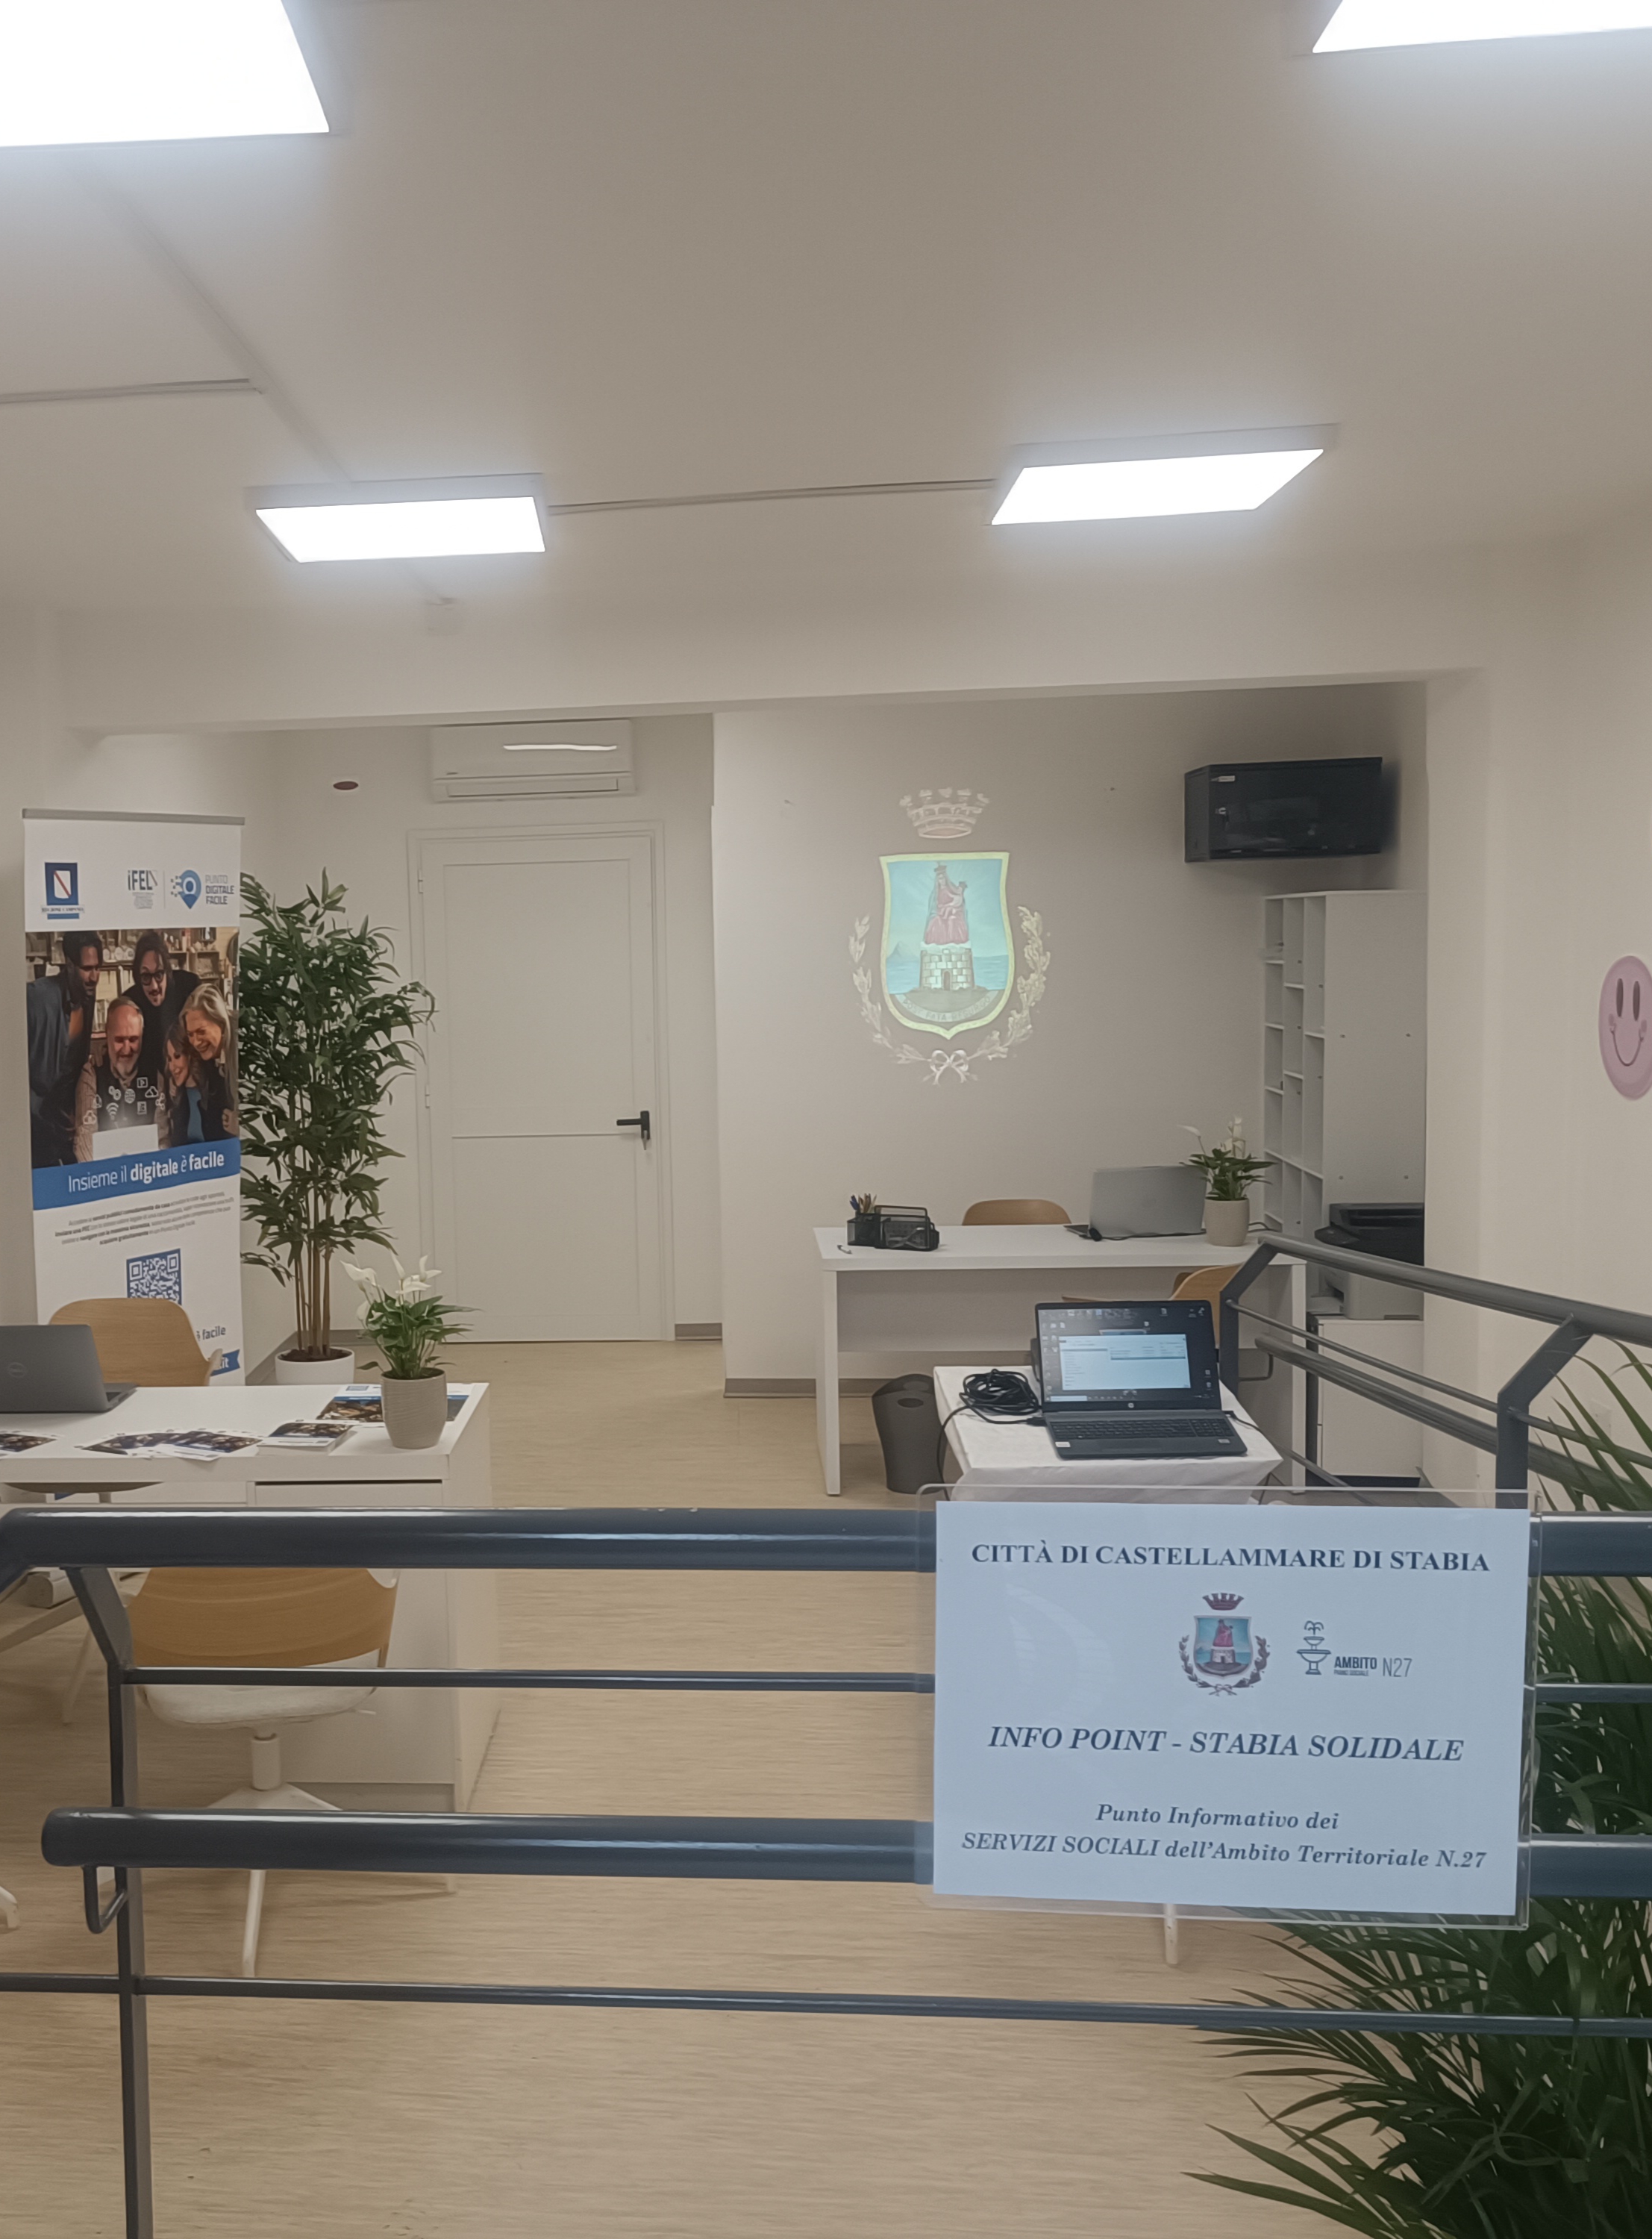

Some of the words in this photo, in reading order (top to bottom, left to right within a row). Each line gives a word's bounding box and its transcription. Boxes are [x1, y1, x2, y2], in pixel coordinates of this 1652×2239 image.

[205, 875, 228, 884] PUNTO
[206, 885, 234, 895] DIGITALE
[206, 896, 228, 905] FACILE
[68, 1170, 118, 1192] Insieme
[120, 1165, 128, 1183] il
[130, 1158, 178, 1184] digitale
[181, 1155, 187, 1172] è
[189, 1151, 225, 1170] facile
[202, 1325, 226, 1340] facile
[972, 1540, 1053, 1563] CITTÀ
[1061, 1546, 1088, 1564] DI
[1096, 1546, 1345, 1568] CASTELLAMMARE
[1354, 1550, 1381, 1569] DI
[1390, 1551, 1490, 1572] STABIA
[1334, 1656, 1377, 1670] AMBITO
[1382, 1658, 1412, 1677] N27
[987, 1726, 1063, 1749] INFO
[1068, 1728, 1168, 1752] POINT
[1189, 1731, 1300, 1756] STABIA
[1307, 1735, 1465, 1761] SOLIDALE
[1095, 1803, 1161, 1823] Punto
[1167, 1806, 1299, 1829] Informativo
[1305, 1811, 1339, 1830] dei
[961, 1832, 1058, 1852] SERVIZI
[1062, 1835, 1161, 1856] SOCIALI
[1298, 1845, 1429, 1867] Territoriale
[1435, 1849, 1487, 1868] N.27
